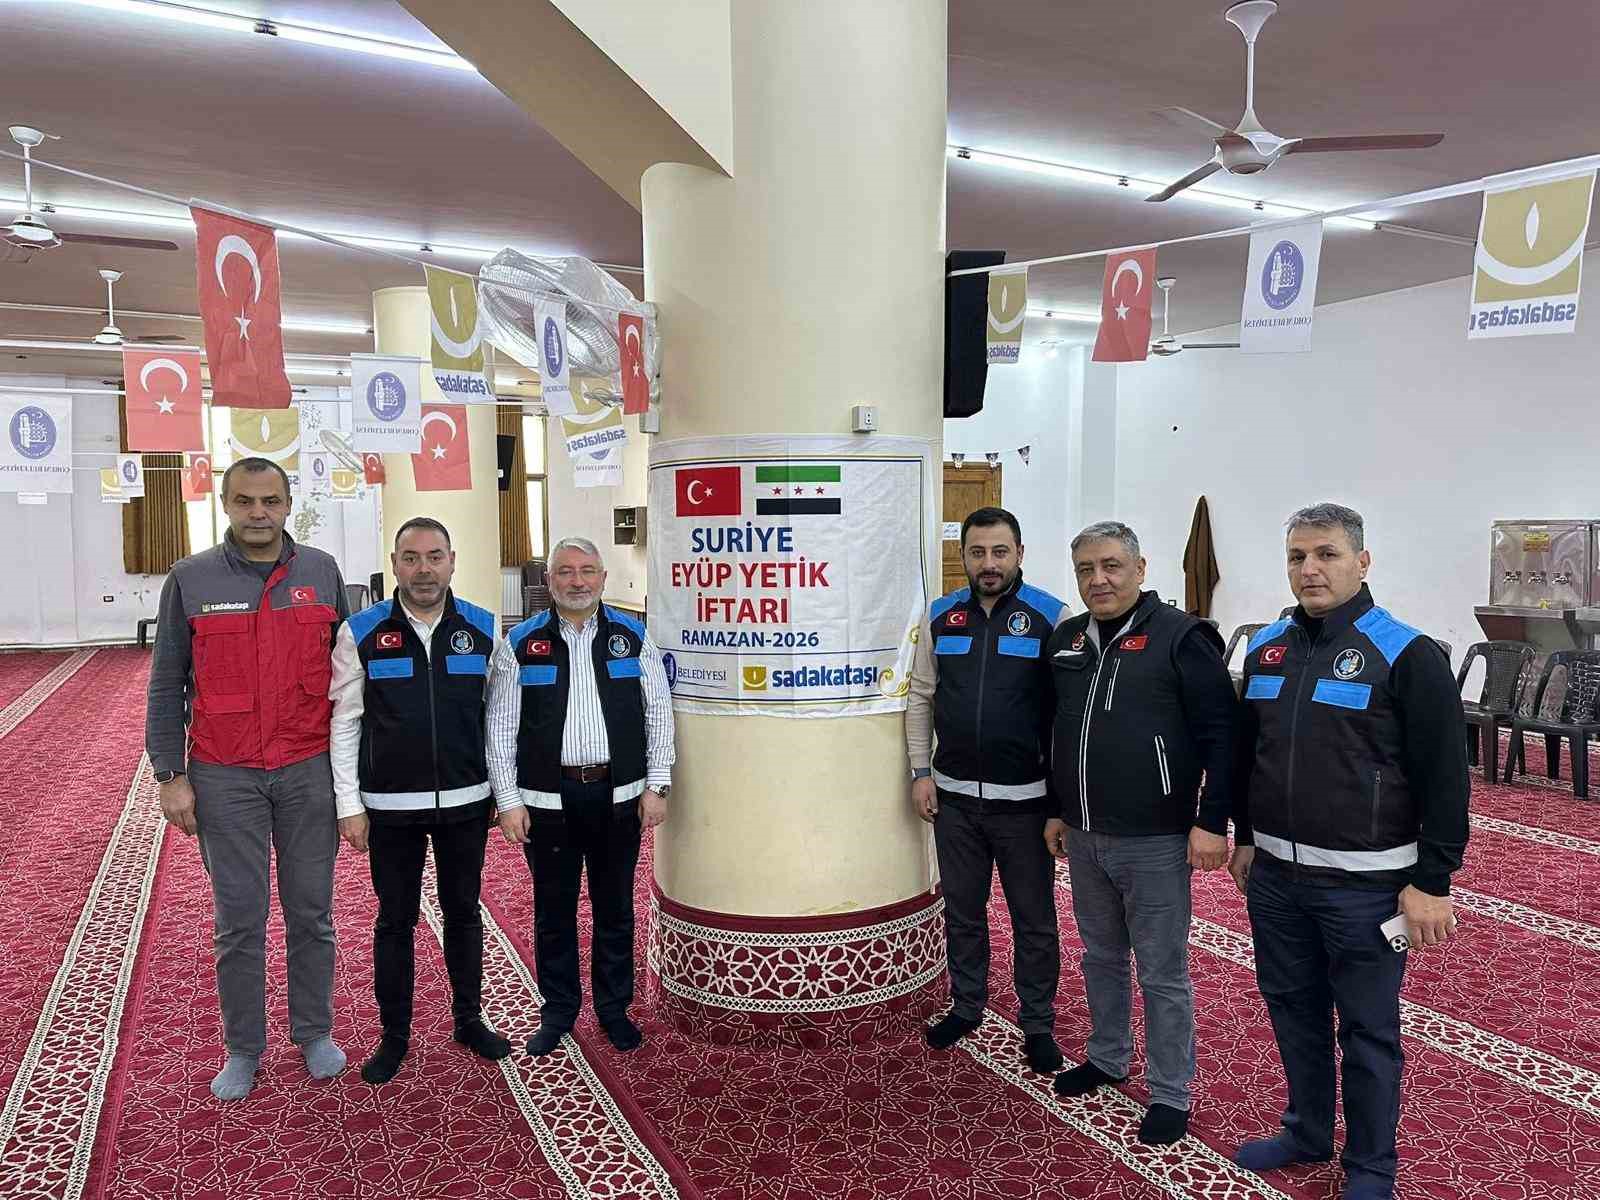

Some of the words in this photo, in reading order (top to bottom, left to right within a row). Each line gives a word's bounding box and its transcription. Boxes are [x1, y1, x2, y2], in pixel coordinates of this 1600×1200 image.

[691, 521, 794, 553] SURİYE
[671, 556, 733, 588] EYÜP
[738, 556, 830, 588] YETİK
[698, 592, 788, 624] İFTARI
[682, 629, 820, 648] RAMAZAN-2026
[772, 664, 878, 689] sadakataşı
